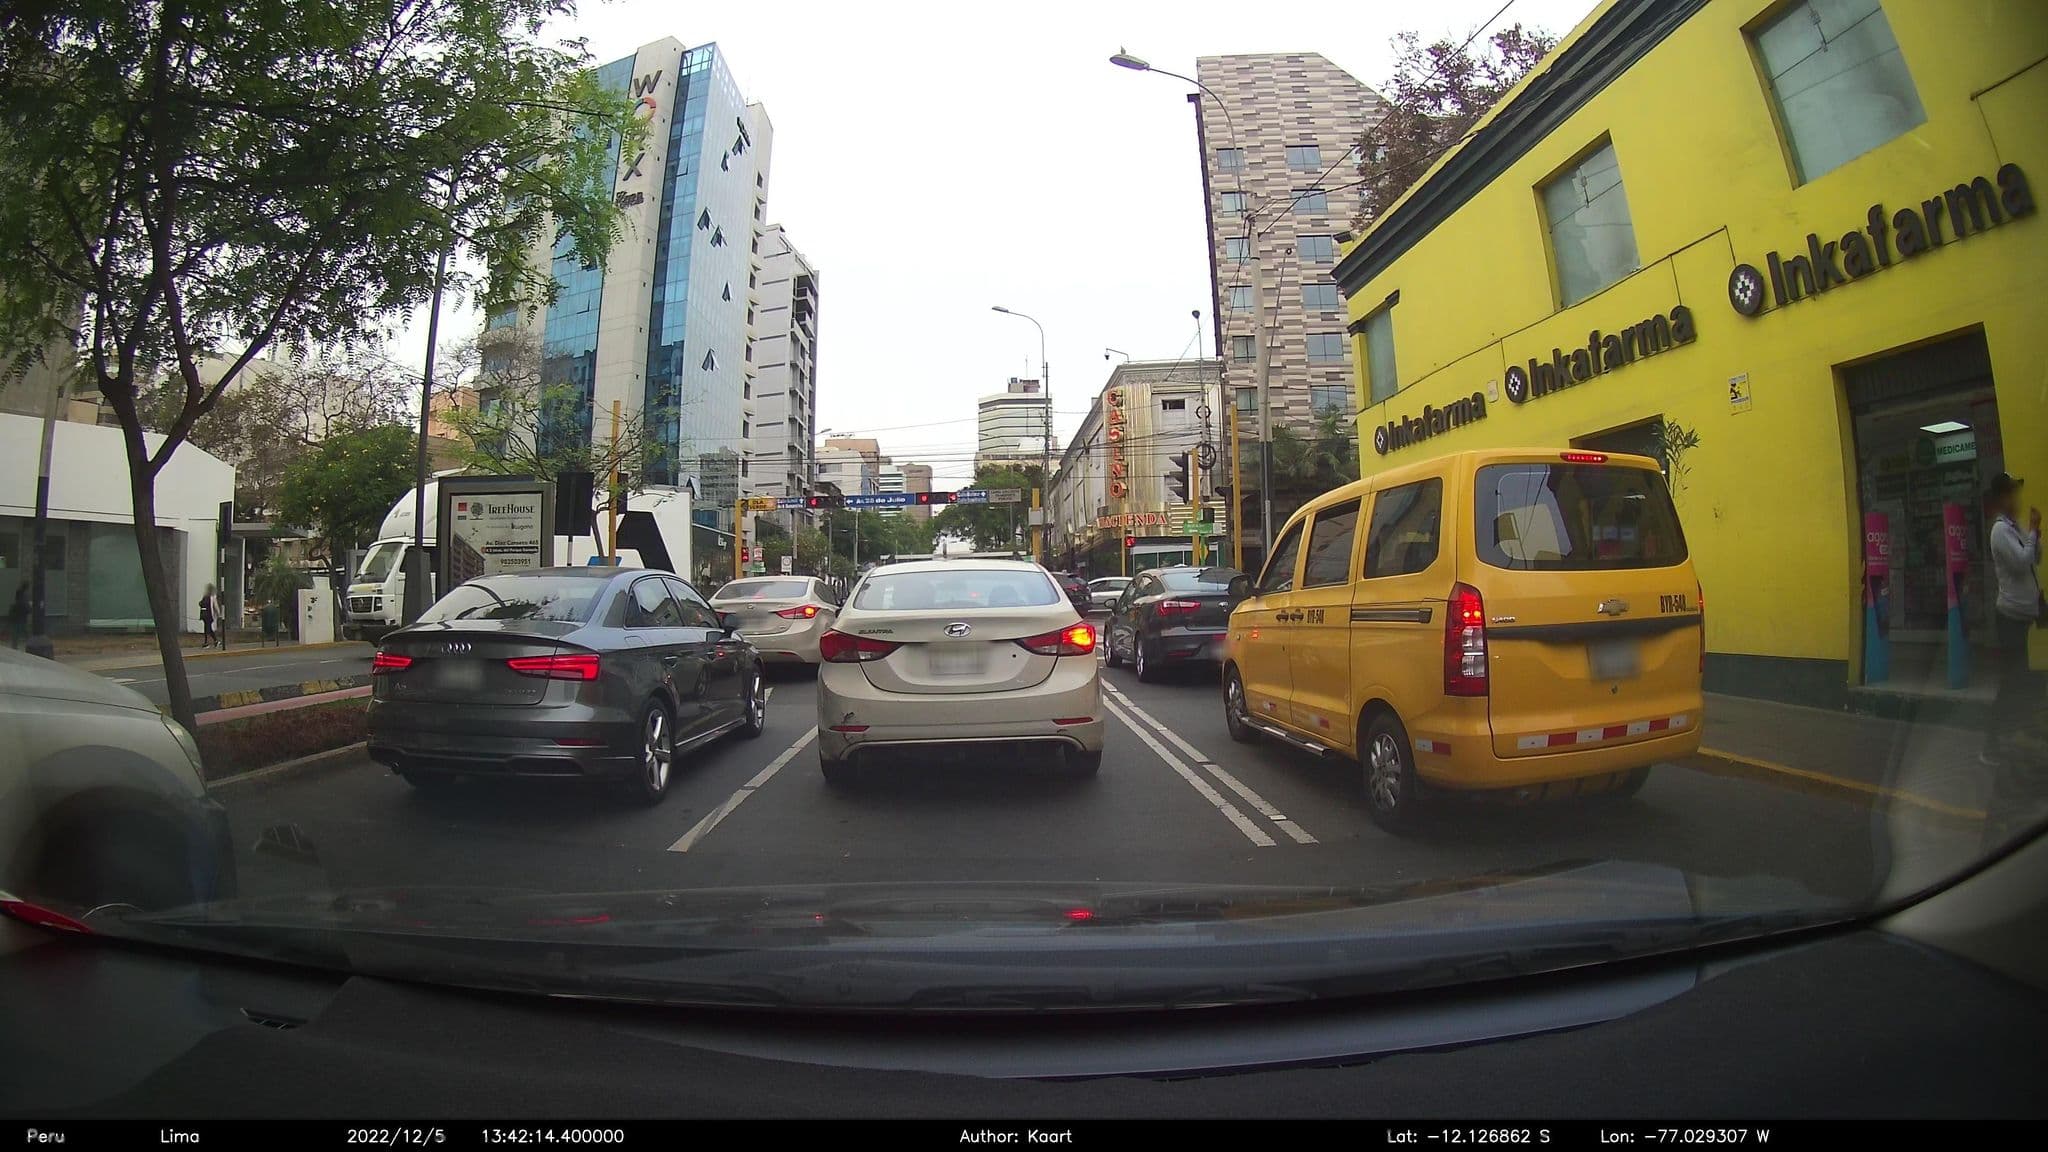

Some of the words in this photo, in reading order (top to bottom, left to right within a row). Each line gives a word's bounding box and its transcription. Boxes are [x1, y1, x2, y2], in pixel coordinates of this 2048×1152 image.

[622, 69, 663, 182] WOX
[1765, 162, 2036, 306] Inkafarma
[1527, 305, 1698, 397] Inkafarma
[1107, 390, 1127, 499] CASINO
[1387, 391, 1488, 450] Inkafarma
